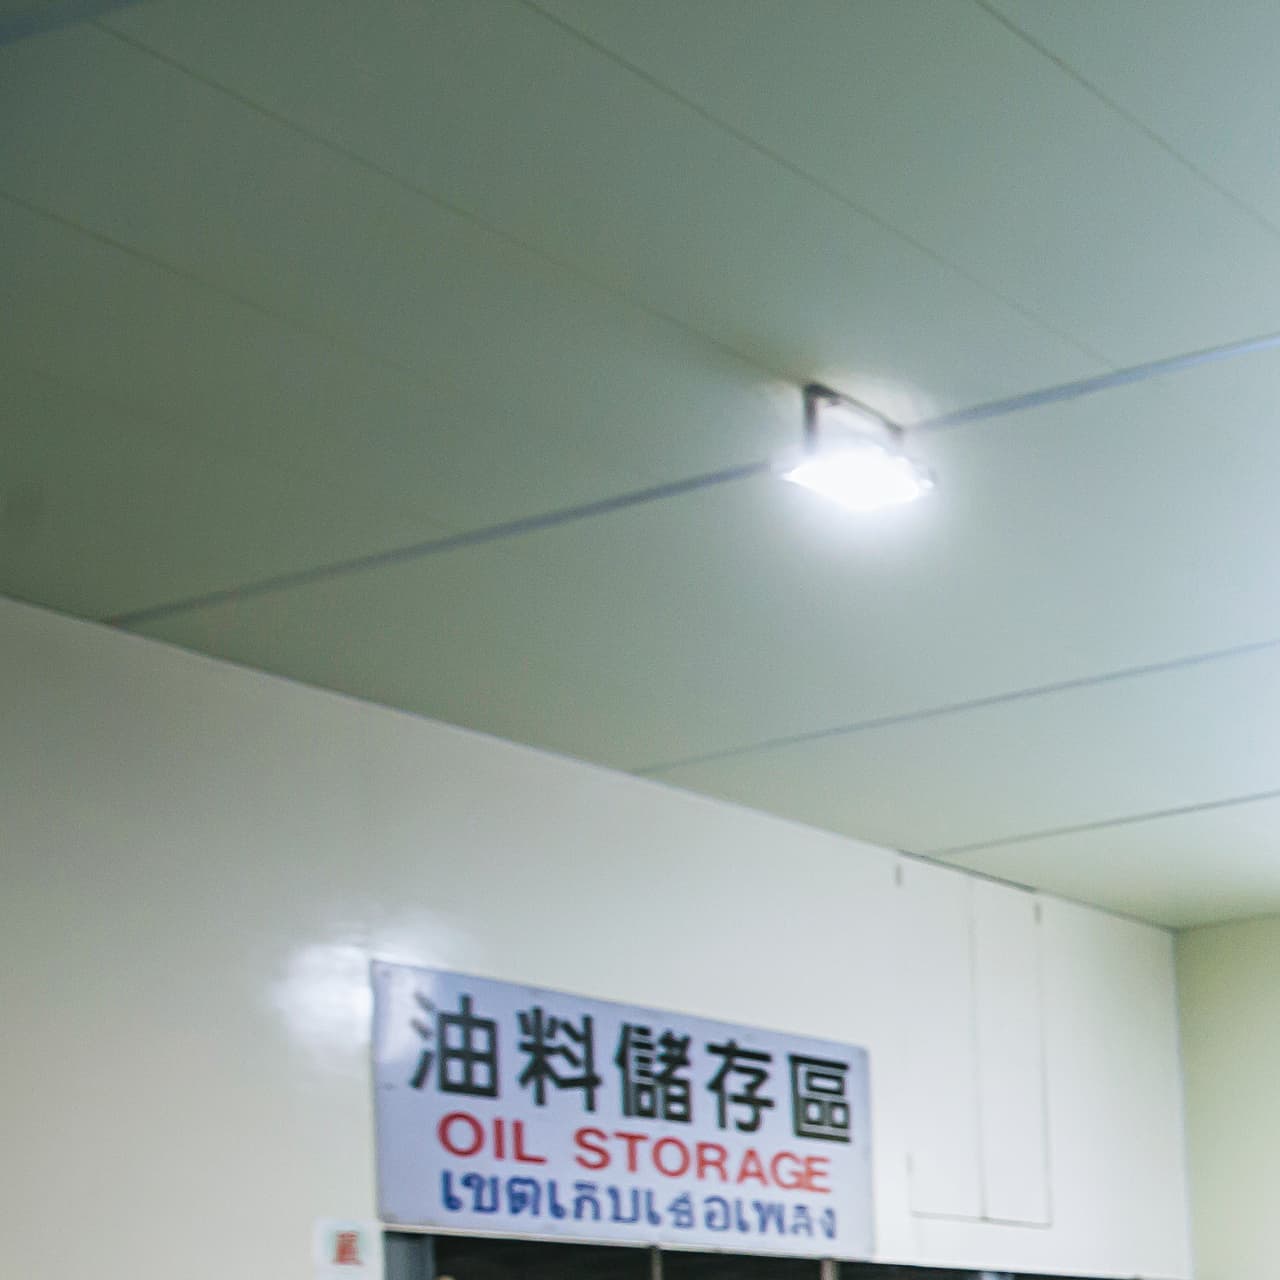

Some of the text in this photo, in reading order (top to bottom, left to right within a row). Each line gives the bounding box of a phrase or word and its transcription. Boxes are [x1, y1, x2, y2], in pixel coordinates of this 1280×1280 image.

[409, 992, 852, 1144] 油料儲存區
[437, 1111, 833, 1194] OIL STORAGE
